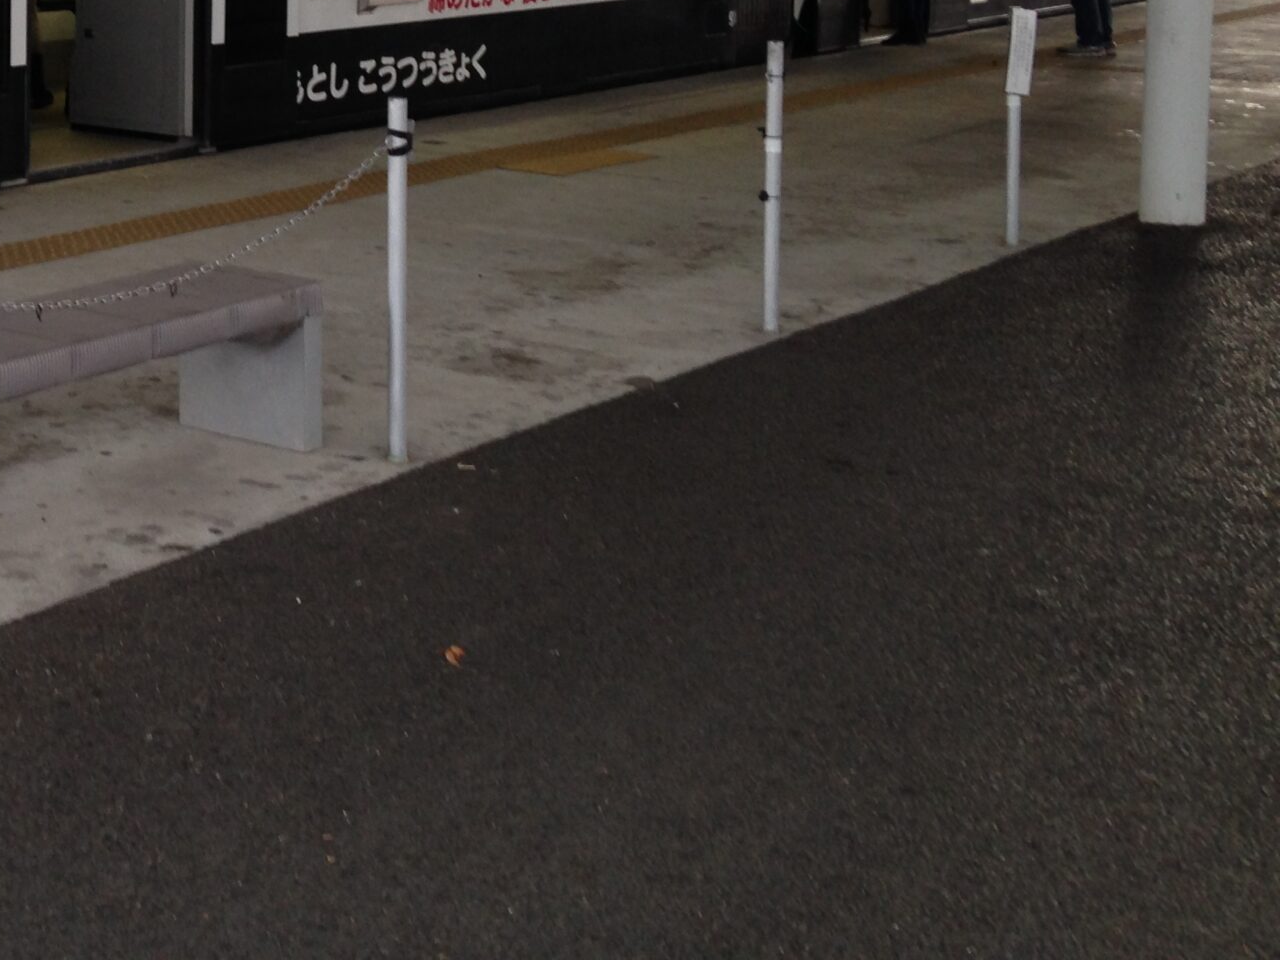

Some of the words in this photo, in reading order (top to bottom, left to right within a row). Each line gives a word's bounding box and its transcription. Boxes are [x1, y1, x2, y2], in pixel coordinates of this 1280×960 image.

[358, 43, 487, 94] こうつうきょく
